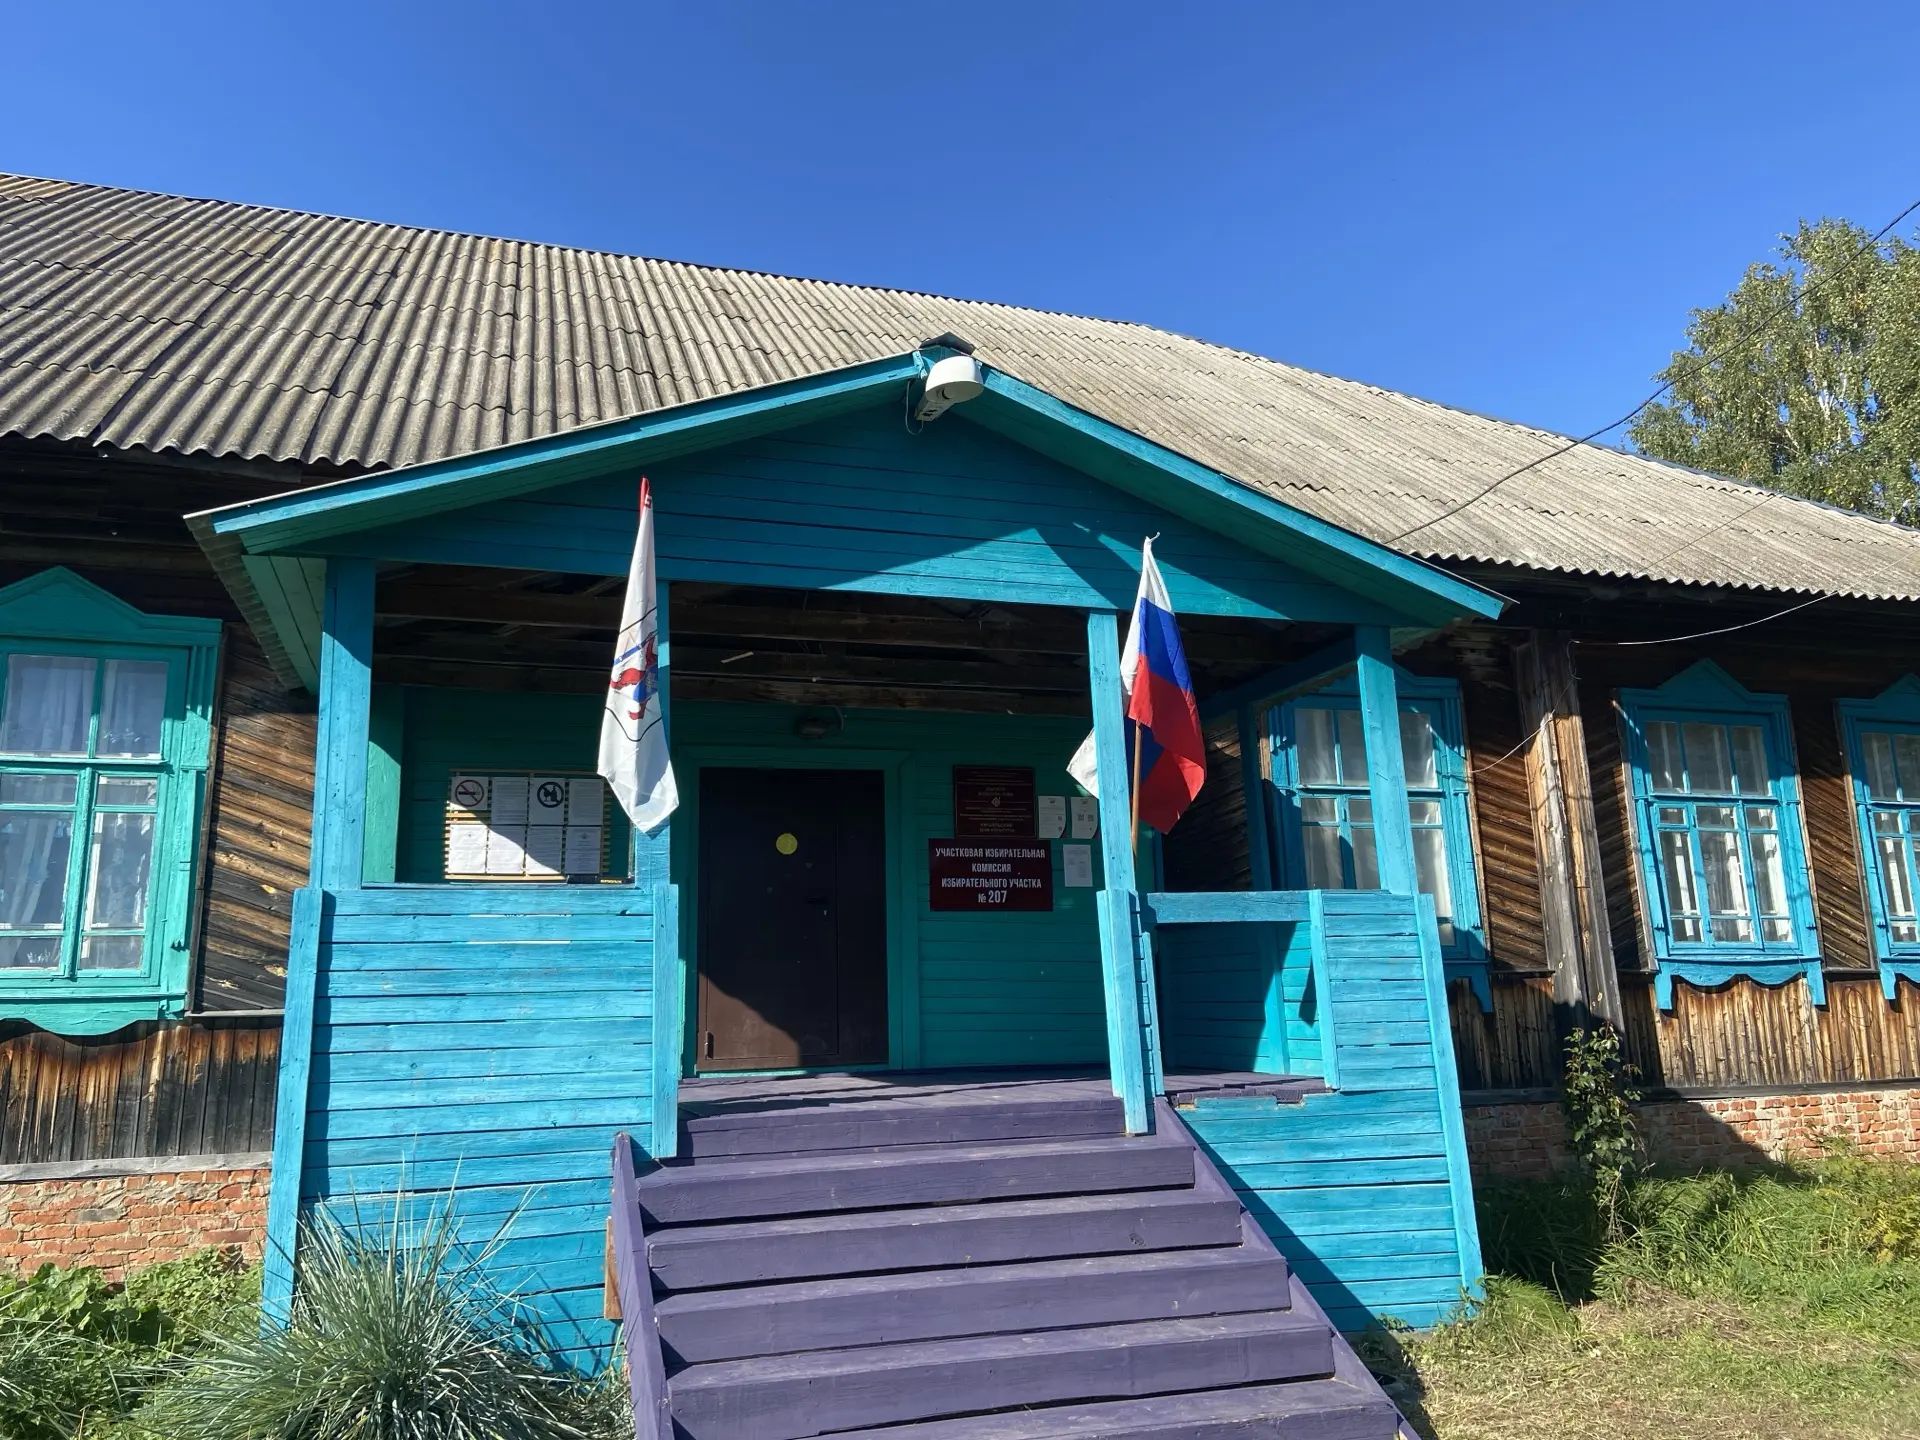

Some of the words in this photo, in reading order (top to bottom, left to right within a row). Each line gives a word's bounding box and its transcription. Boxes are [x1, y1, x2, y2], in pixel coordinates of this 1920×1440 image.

[935, 847, 983, 857] УЧАСТКОВАЯ
[985, 848, 1046, 858] ИЗБИРАТЕЛЬНАЯ
[971, 863, 1012, 872] КОМИССИЯ
[941, 877, 1008, 888] ИЗБИРАТЕЛЬНОГО
[1009, 878, 1042, 888] УЧАСТКА
[978, 893, 987, 903] №
[988, 890, 1008, 903] 207
